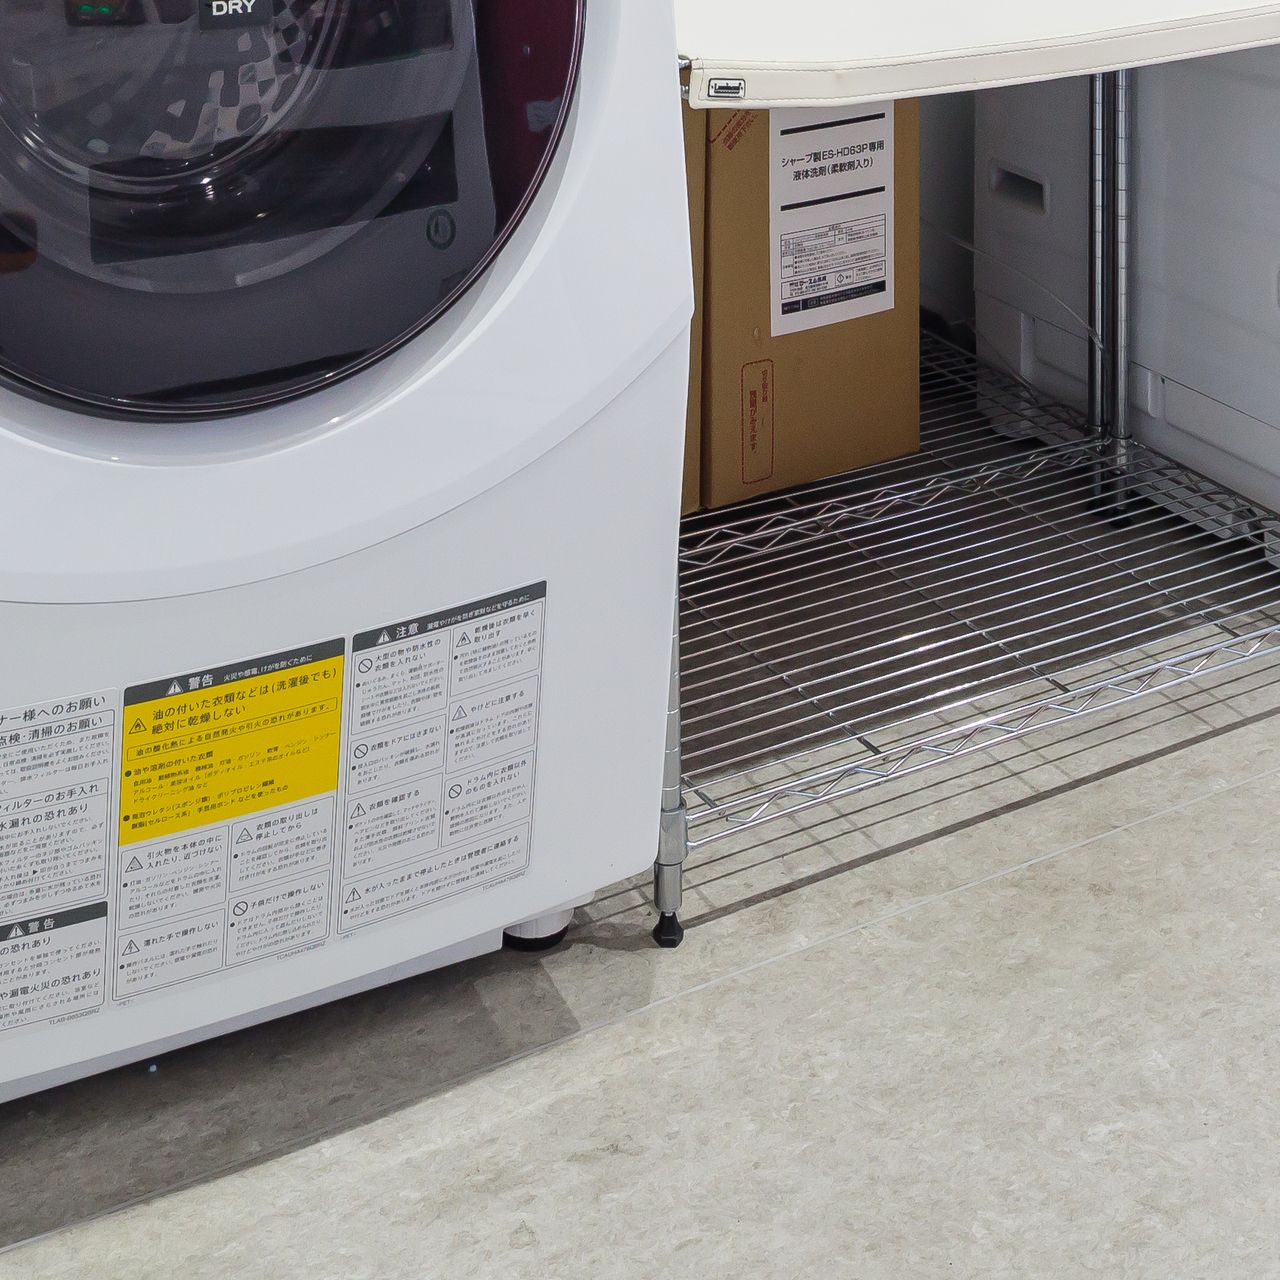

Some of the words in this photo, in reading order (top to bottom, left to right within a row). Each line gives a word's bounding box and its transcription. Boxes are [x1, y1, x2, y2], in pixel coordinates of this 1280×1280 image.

[781, 140, 884, 167] シャープ製ES-HD63P専用
[793, 157, 873, 181] 液体洗剤（柔軟剤入り）
[396, 623, 419, 638] 注意
[474, 630, 501, 642] 取り出す
[375, 653, 426, 671] 衣類を入れない
[188, 675, 214, 690] 警告
[152, 668, 337, 720] 油の付いた衣類などは（洗濯後でも）
[471, 691, 525, 712] やけどに注意する
[152, 706, 246, 734] 絶対に乾燥しない
[371, 726, 442, 751] 衣類をドアにはさまない
[370, 790, 420, 810] 衣類を確認する
[256, 808, 318, 830] 衣類の取り出しは
[256, 822, 302, 840] 停止してから
[147, 835, 221, 860] 引火物を本体の中に
[251, 883, 325, 908] 子供だけで操作しない
[28, 919, 55, 933] 警告
[144, 921, 219, 947] 濡れた手で操作しない
